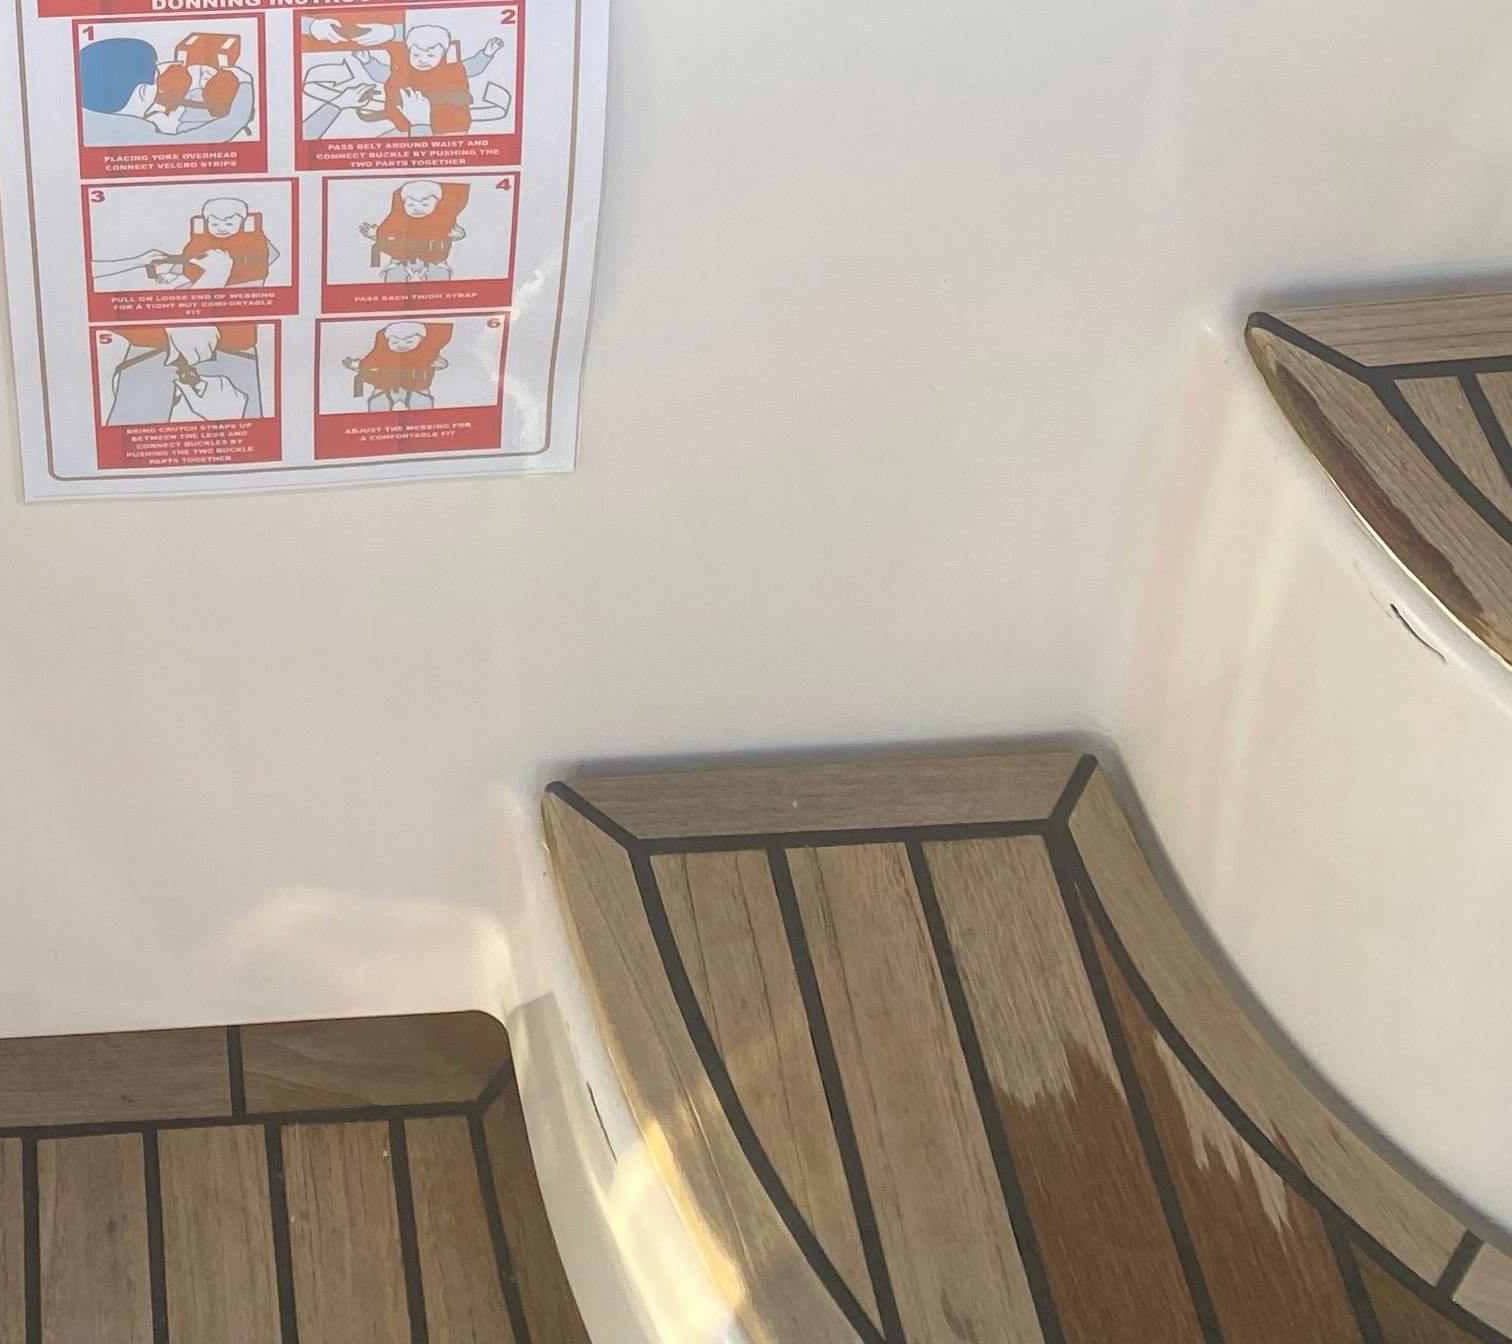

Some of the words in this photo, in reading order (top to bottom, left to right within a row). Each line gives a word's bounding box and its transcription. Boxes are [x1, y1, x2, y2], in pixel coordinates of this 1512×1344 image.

[500, 9, 516, 24] 2
[83, 26, 94, 40] 1
[496, 178, 511, 190] 4
[91, 190, 105, 203] 3
[487, 318, 501, 328] 6
[99, 333, 112, 344] 5
